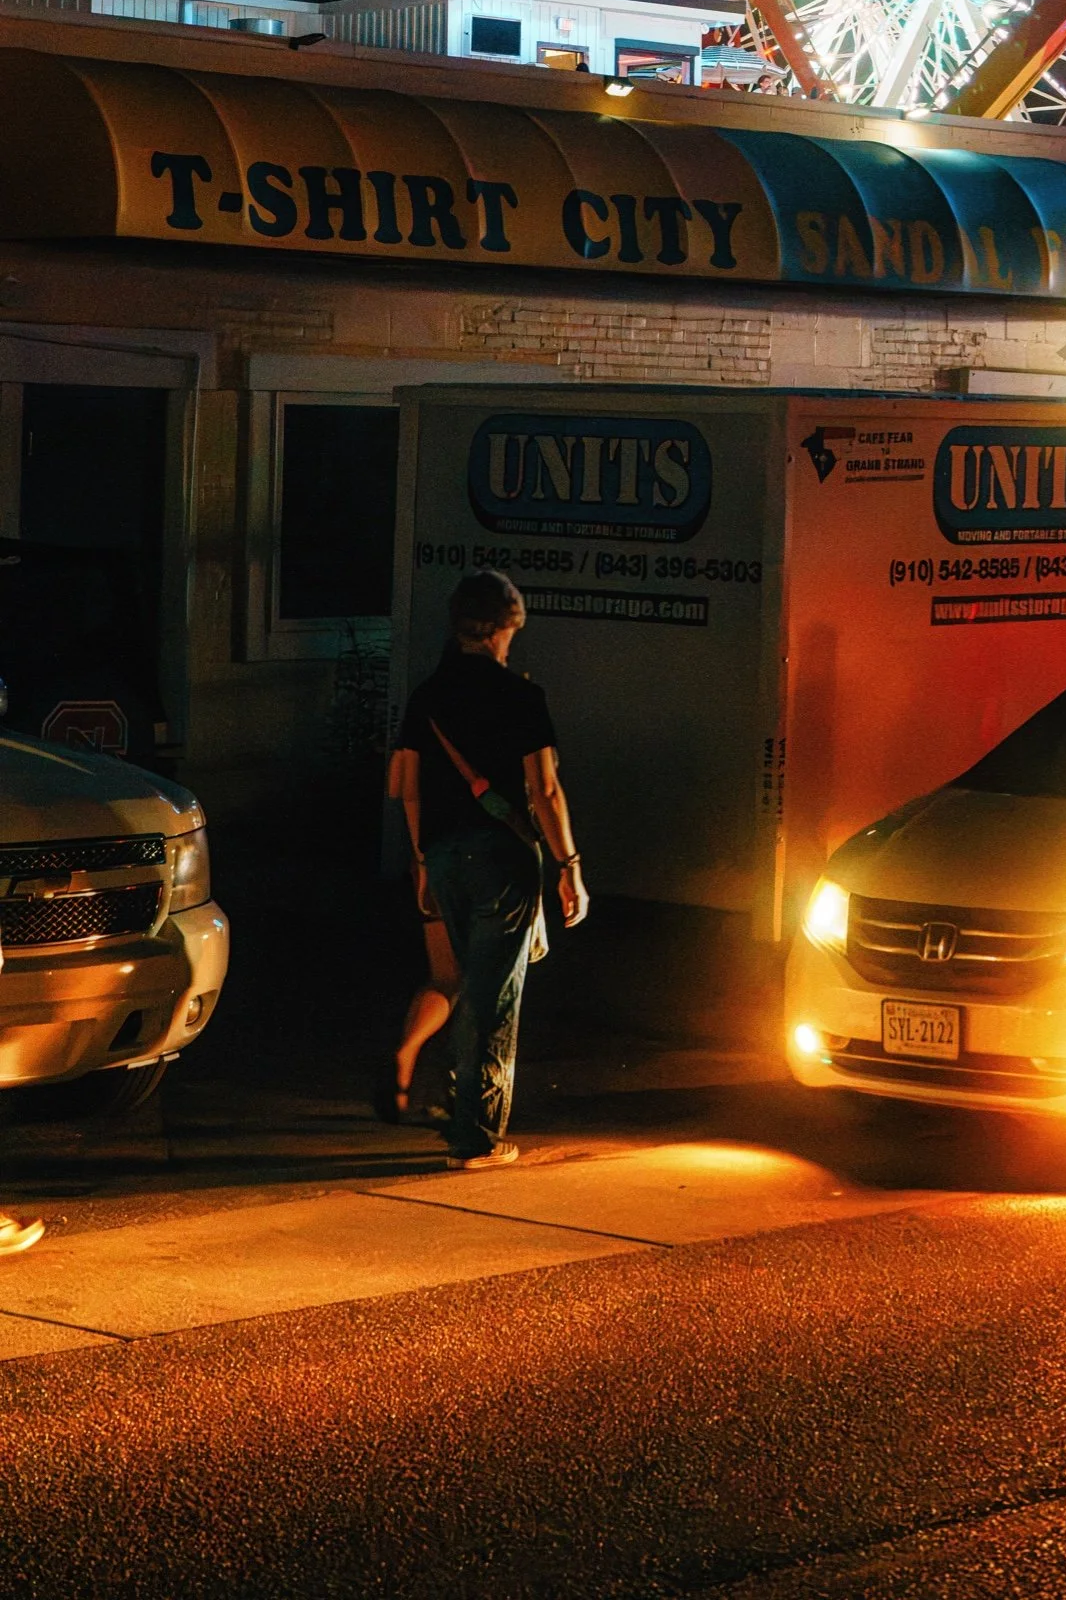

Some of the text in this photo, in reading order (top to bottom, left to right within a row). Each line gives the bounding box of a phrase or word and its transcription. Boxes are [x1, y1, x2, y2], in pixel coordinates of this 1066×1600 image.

[151, 151, 742, 269] T-SHIRT CITY
[797, 212, 1013, 290] SANDAL
[887, 431, 913, 443] FEAR
[488, 432, 690, 508] UNITS
[540, 521, 565, 534] AND
[567, 522, 623, 537] PORTABLE
[626, 526, 678, 540] STORAGE
[957, 529, 992, 542] MOVING
[994, 530, 1011, 541] AND
[1013, 529, 1056, 541] PORTABLE
[416, 543, 466, 569] (910)
[578, 550, 590, 573] /
[594, 551, 648, 581] (843)
[654, 556, 763, 584] 396-5303
[889, 559, 934, 586] (910)
[938, 556, 1020, 581] 542-8585
[1023, 556, 1032, 578] /
